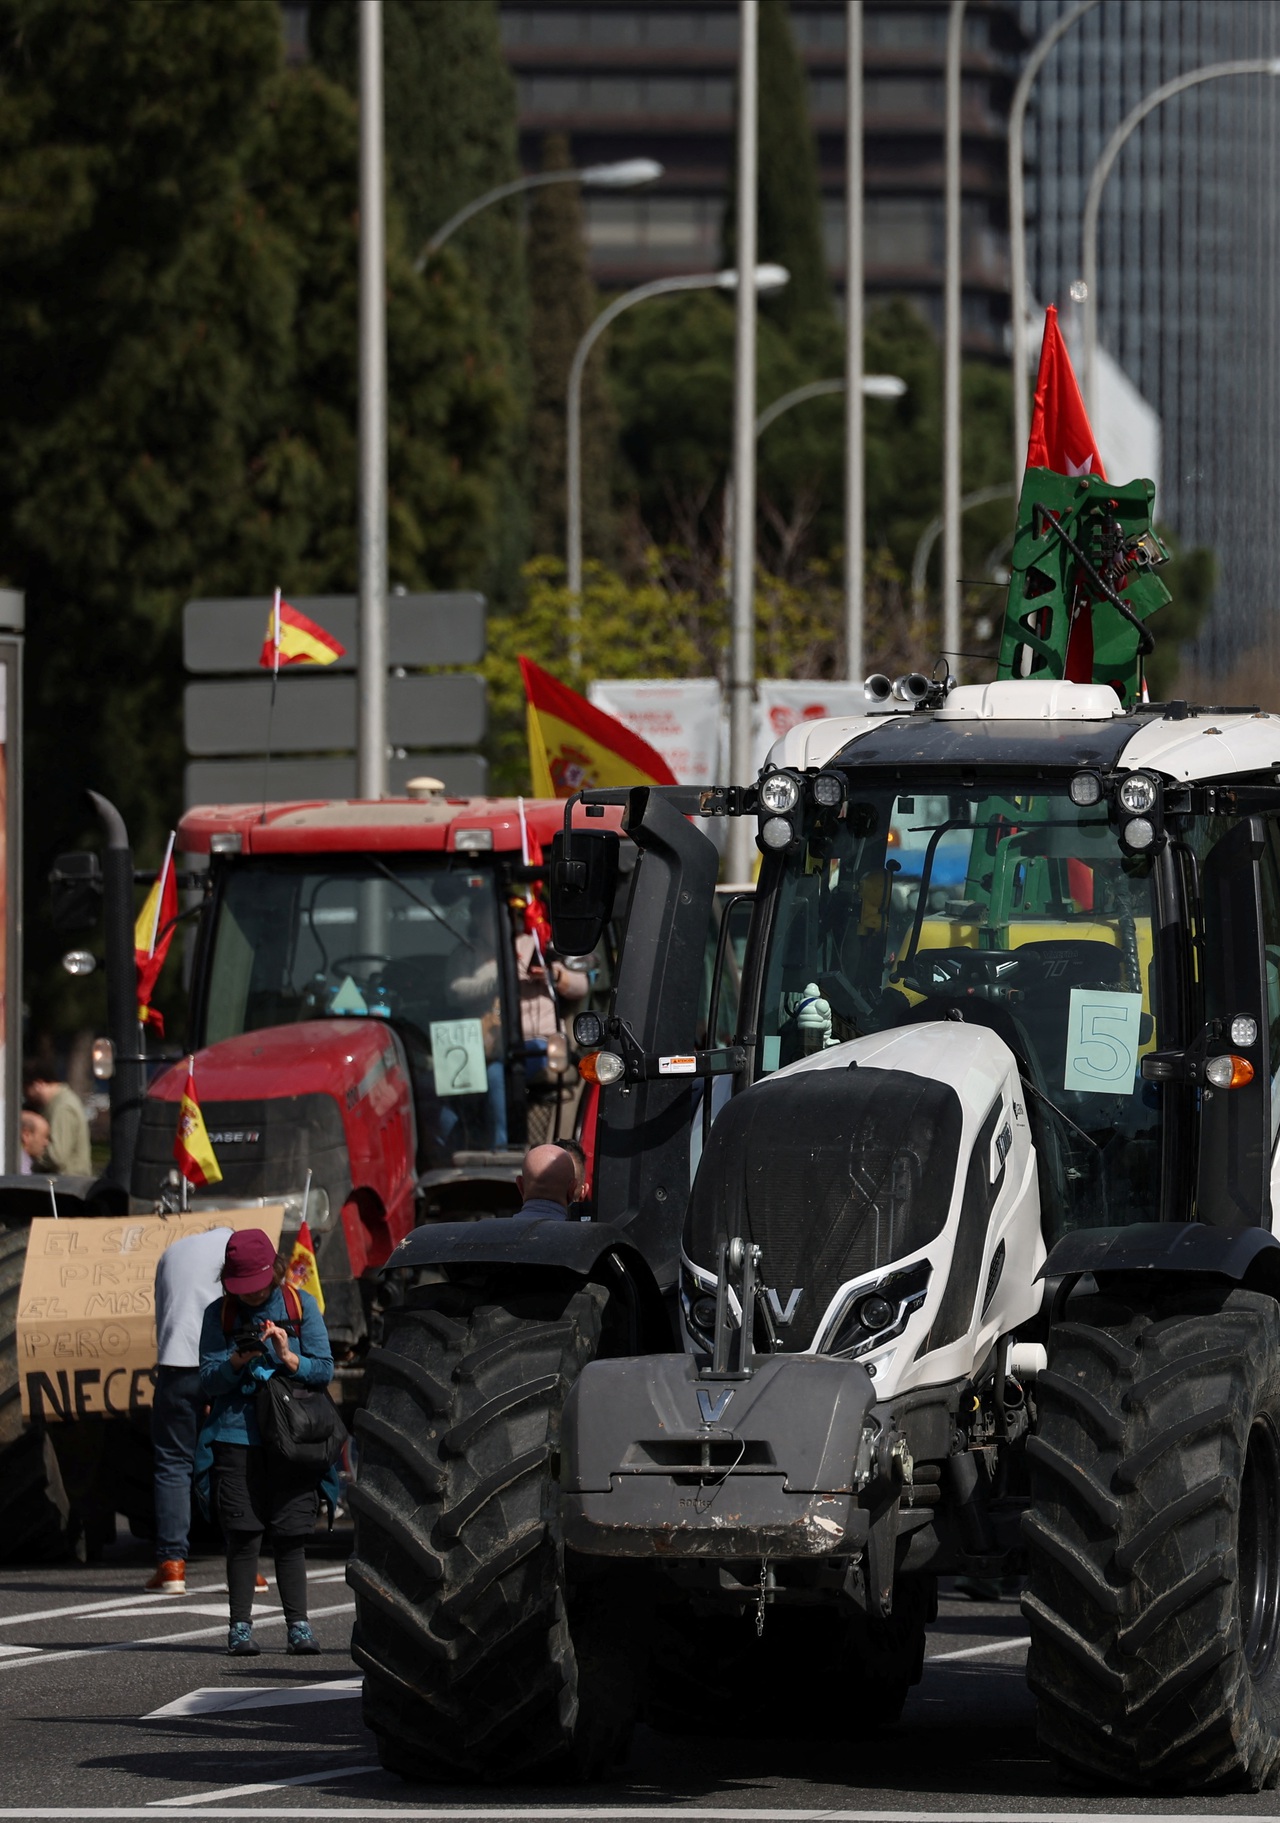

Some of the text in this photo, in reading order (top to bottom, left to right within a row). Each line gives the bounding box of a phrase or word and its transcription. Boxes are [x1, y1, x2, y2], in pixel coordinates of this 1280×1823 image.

[436, 1024, 480, 1046] RUTA
[1072, 1004, 1132, 1081] 5
[445, 1045, 472, 1089] 2
[207, 1131, 244, 1143] CASE
[44, 1231, 88, 1256] EL
[20, 1285, 152, 1319] EL MAS
[23, 1321, 131, 1359] PERO
